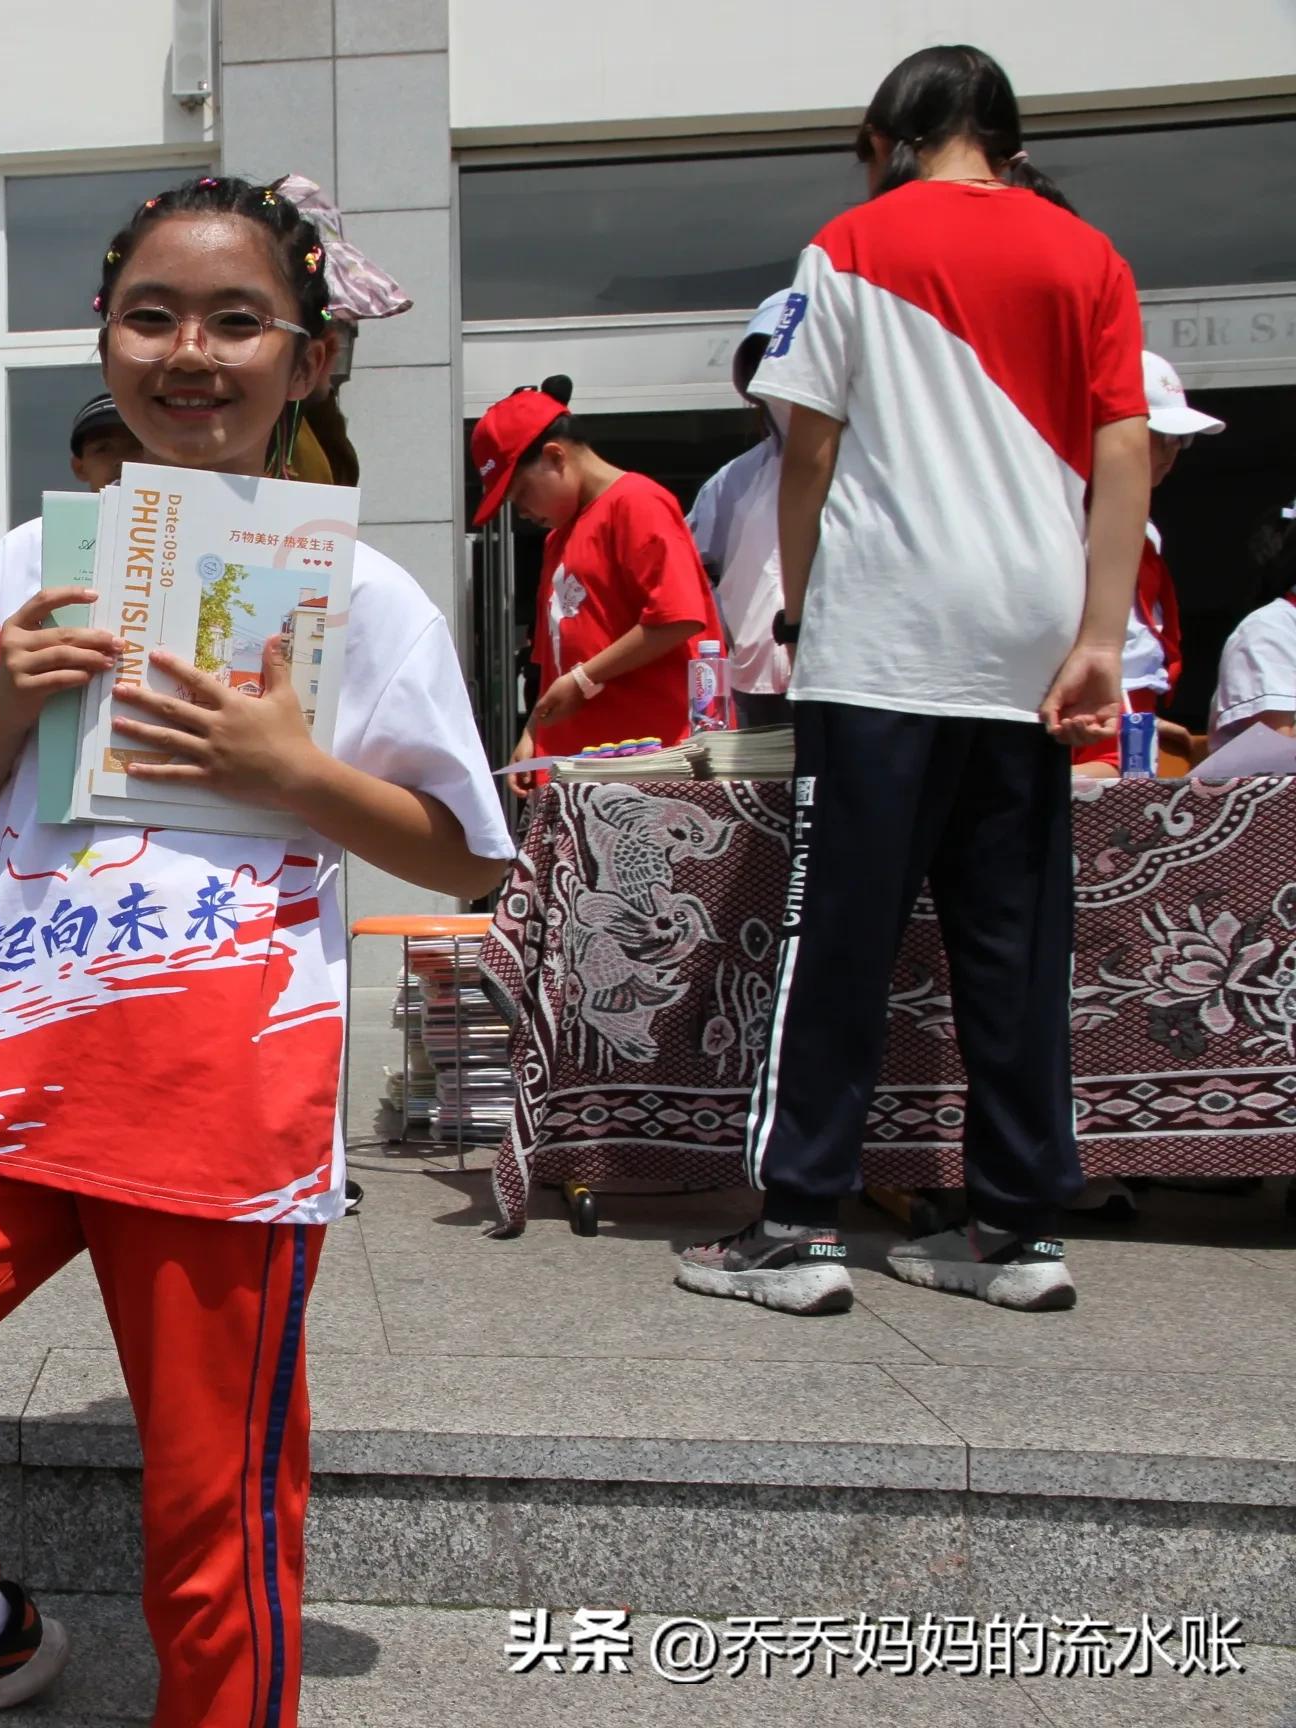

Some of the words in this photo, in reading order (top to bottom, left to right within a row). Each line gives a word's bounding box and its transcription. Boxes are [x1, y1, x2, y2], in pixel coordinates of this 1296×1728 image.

[125, 489, 161, 598] PHUKET
[160, 494, 182, 588] Date:09:30
[229, 529, 279, 546] 万物美好
[283, 535, 335, 552] 热爱生活
[782, 853, 809, 927] CHINA
